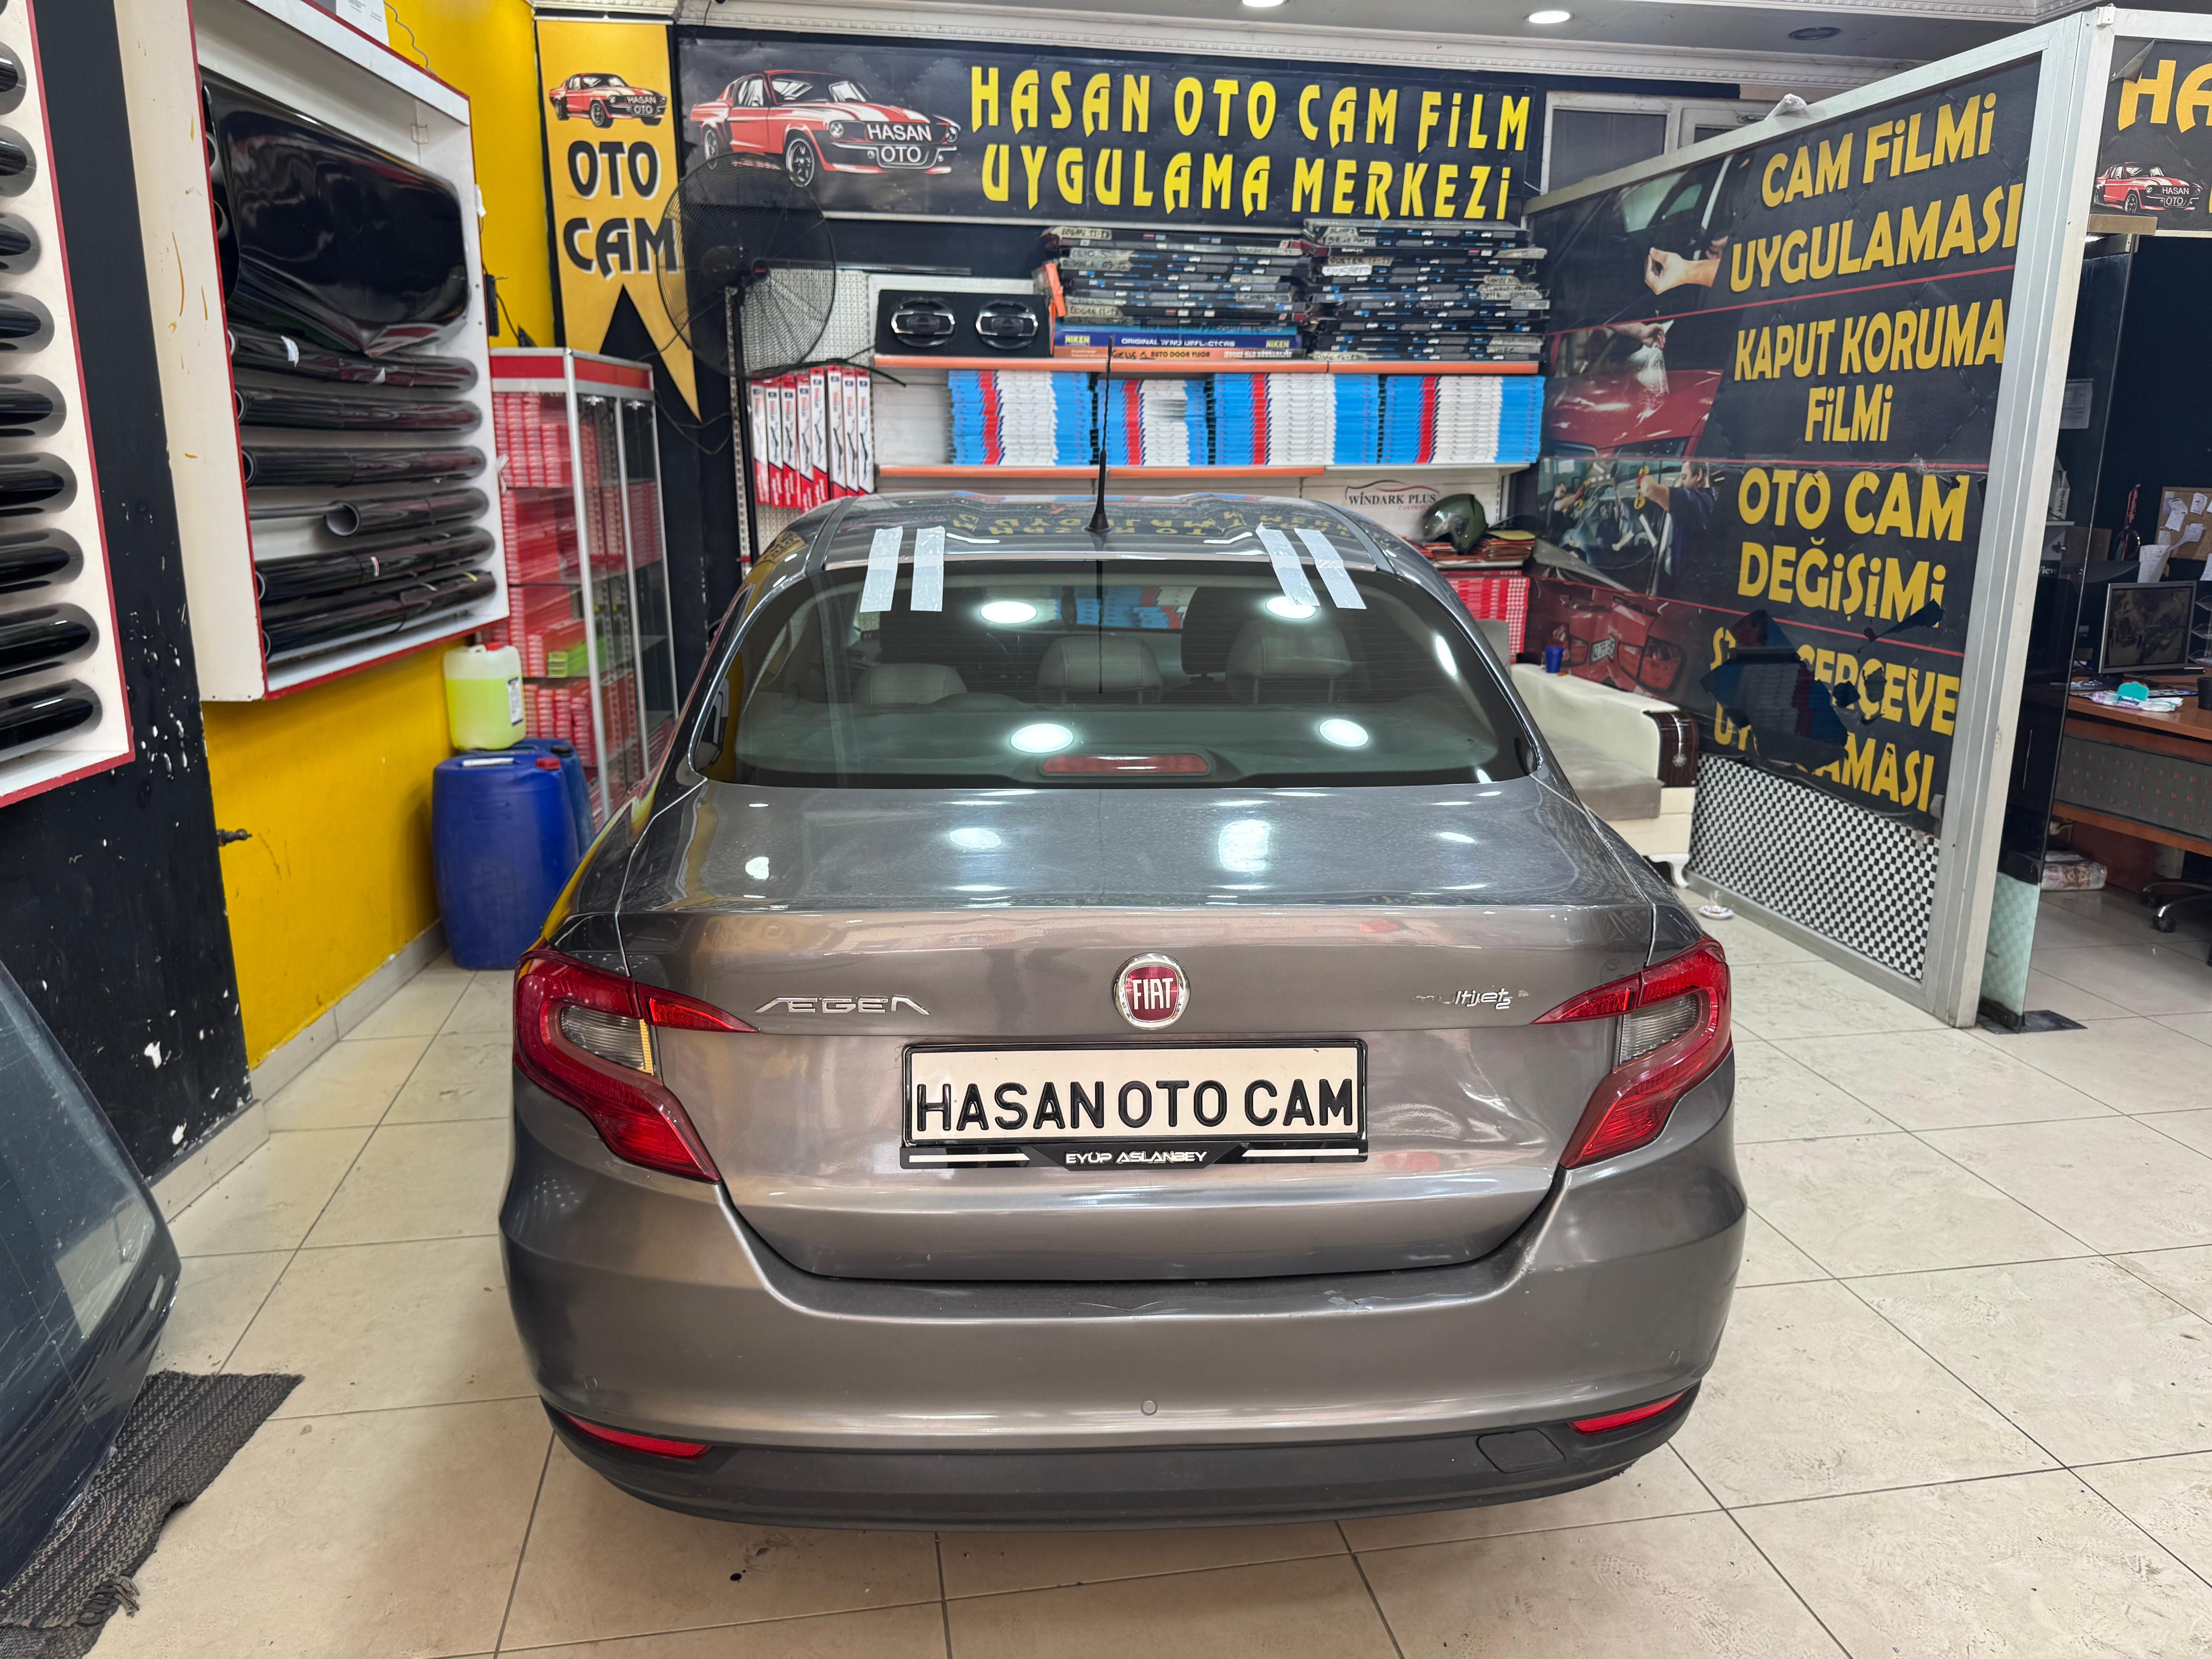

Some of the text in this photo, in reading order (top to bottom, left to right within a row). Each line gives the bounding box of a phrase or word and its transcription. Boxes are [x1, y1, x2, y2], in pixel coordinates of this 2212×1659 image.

[633, 105, 653, 114] OTO
[972, 67, 1150, 136] HASAN
[1175, 78, 1277, 140] OTO
[1299, 85, 1398, 148] CAM
[867, 124, 932, 141] HASAN
[881, 146, 922, 162] OTO
[568, 140, 661, 200] OTO
[982, 145, 1270, 216] UYGULAMA
[1762, 134, 1853, 207] CAM
[2162, 187, 2190, 195] HASAN
[2165, 197, 2184, 205] OTO
[563, 218, 680, 281] CAM
[1731, 184, 2024, 292] UYGULAMASI
[1065, 335, 1090, 345] NIKEN
[1265, 340, 1290, 349] NIKEN
[1735, 300, 2005, 381] KAPUT KORUMA
[1408, 494, 1437, 505] PLUS
[1738, 468, 1970, 542] OTO CAM
[1131, 977, 1175, 1010] FIAT
[917, 1079, 1353, 1132] HASAN OTO CAM
[1116, 1151, 1208, 1163] ASLANBEY
